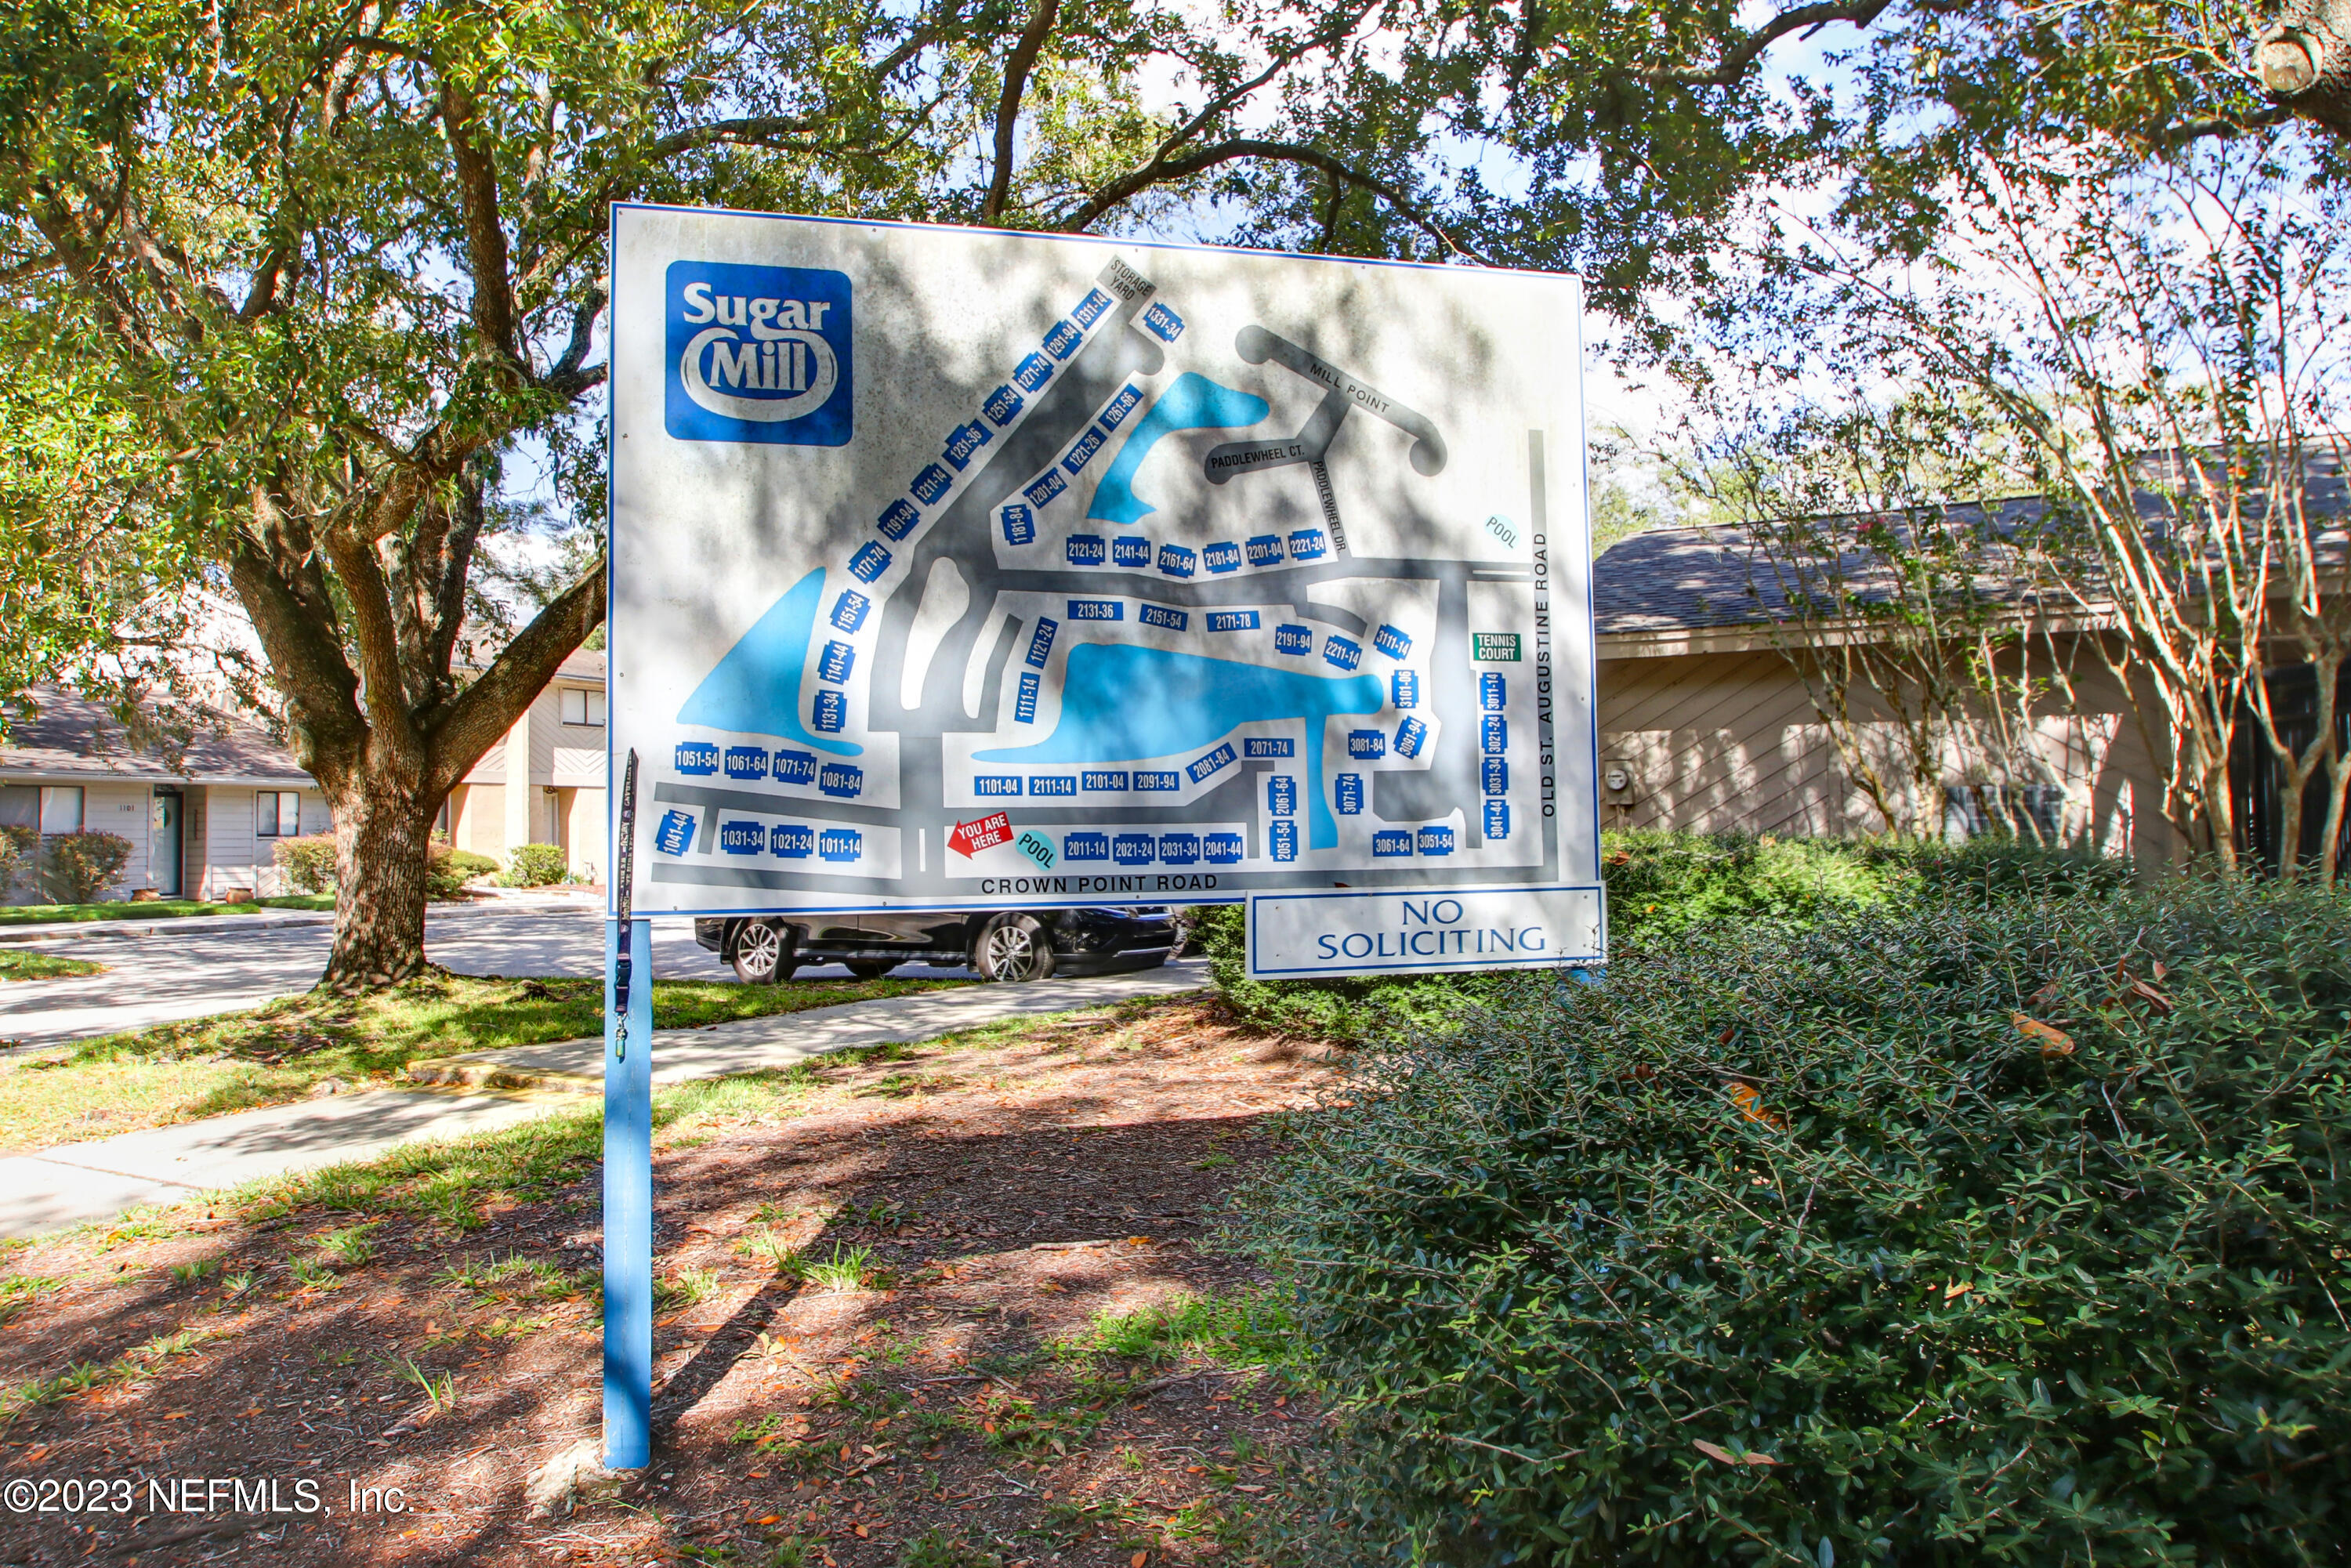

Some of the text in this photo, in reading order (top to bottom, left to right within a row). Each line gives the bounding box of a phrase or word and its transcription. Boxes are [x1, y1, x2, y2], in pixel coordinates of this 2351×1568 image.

[1110, 259, 1152, 297] STORAGE
[1110, 276, 1136, 301] YARD
[683, 282, 830, 340] Sugar
[1077, 292, 1109, 325] 1311-14
[1148, 306, 1181, 339] 1331-34
[1047, 324, 1078, 357] 1291-94
[708, 341, 808, 391] Mill
[1018, 355, 1049, 389] 1271-74
[1310, 364, 1389, 413] MILL POINT
[987, 388, 1018, 421] 1251-54
[1106, 392, 1136, 425] 1261-66
[950, 427, 983, 461] 1231-36
[1069, 433, 1100, 467] 1221-26
[1211, 444, 1305, 469] PADDLEWHEEL CT.
[917, 468, 947, 500] 1211-14
[1029, 473, 1064, 505] 1201-04
[883, 502, 915, 537] 1191-94
[1313, 461, 1346, 553] PADDLEWHEEL DR.
[1009, 507, 1027, 542] 1181-84
[1486, 516, 1517, 549] POOL
[1069, 543, 1103, 557] 2121-24
[1114, 545, 1149, 559] 2141-44
[1247, 541, 1283, 559] 2201-04
[1290, 536, 1324, 553] 2221-24
[854, 545, 886, 578] 1171-74
[1160, 552, 1194, 570] 2161-64
[1205, 549, 1239, 567] 2181-84
[837, 593, 864, 629] 1151-54
[1078, 603, 1114, 617] 2131-36
[1146, 608, 1181, 628] 2151-54
[1215, 614, 1251, 629] 2171-78
[1030, 624, 1054, 661] 1121-24
[1277, 631, 1310, 649] 2191-94
[1324, 641, 1360, 665] 2211-14
[1376, 630, 1410, 656] 3111-14
[1477, 635, 1516, 646] TENNIS
[826, 643, 849, 680] 1141-44
[1478, 648, 1516, 660] COURT
[1398, 670, 1412, 707] 3101-06
[1534, 534, 1555, 817] OLD ST. AUGUSTINE ROAD
[1018, 679, 1037, 717] 1111-14
[1487, 673, 1499, 710] 3011-14
[820, 693, 839, 730] 1131-34
[1350, 738, 1383, 752] 3081-84
[1399, 719, 1423, 755] 3091-94
[1488, 715, 1501, 752] 3021-24
[676, 750, 718, 767] 1051-54
[1251, 741, 1288, 755] 2071-74
[726, 755, 767, 771] 1061-64
[775, 758, 814, 777] 1071-74
[1194, 748, 1230, 779] 2081-84
[822, 771, 860, 790] 1081-84
[980, 778, 1018, 794] 1101-04
[1034, 778, 1071, 794] 2111-14
[1085, 774, 1124, 789] 2101-04
[1138, 774, 1175, 788] 2091-94
[1489, 759, 1502, 794] 3031-34
[1276, 777, 1289, 815] 2061-64
[1343, 775, 1356, 813] 3071-74
[663, 812, 689, 853] 1041-44
[958, 814, 1007, 839] YOU ARE
[1491, 801, 1503, 838] 3041-44
[723, 830, 764, 846] 1031-34
[772, 833, 813, 850] 1021-24
[820, 837, 861, 854] 1011-14
[971, 831, 1002, 850] HERE
[1018, 833, 1054, 869] POOL
[1067, 842, 1106, 856] 2011-14
[1116, 842, 1153, 857] 2021-24
[1161, 842, 1198, 856] 2031-34
[1205, 841, 1242, 856] 2041-44
[1277, 821, 1291, 860] 2051-54
[1375, 838, 1410, 853] 3061-64
[1418, 834, 1452, 849] 3051-54
[982, 875, 1217, 894] CROWN POINT ROAD
[1402, 899, 1464, 925] NO
[1318, 926, 1545, 960] SOLICITING
